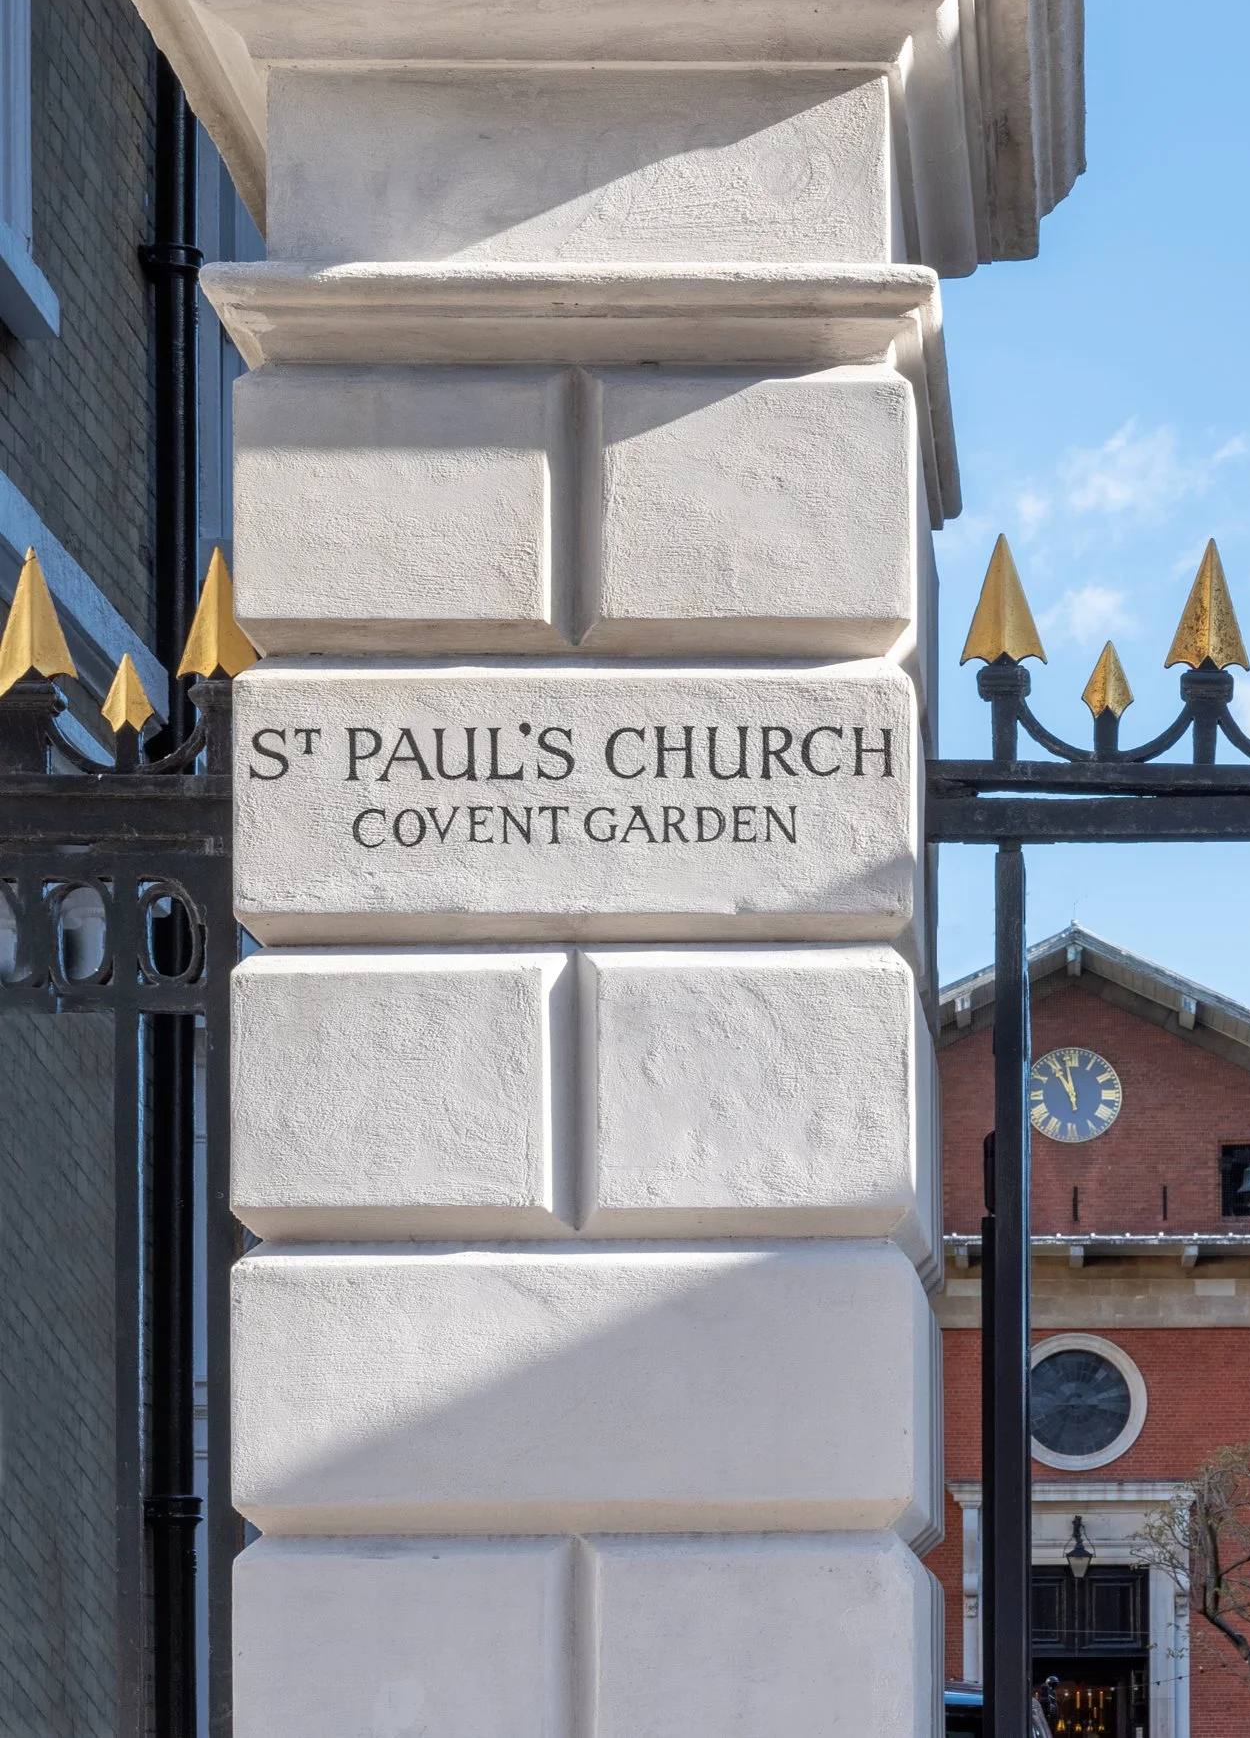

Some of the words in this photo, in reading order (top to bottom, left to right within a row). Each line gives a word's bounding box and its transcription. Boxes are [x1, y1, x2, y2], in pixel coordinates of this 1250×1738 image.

[346, 723, 575, 782] PAUL'S
[605, 726, 895, 780] CHURCH
[352, 806, 569, 849] COVENT
[584, 805, 796, 844] GARDEN
